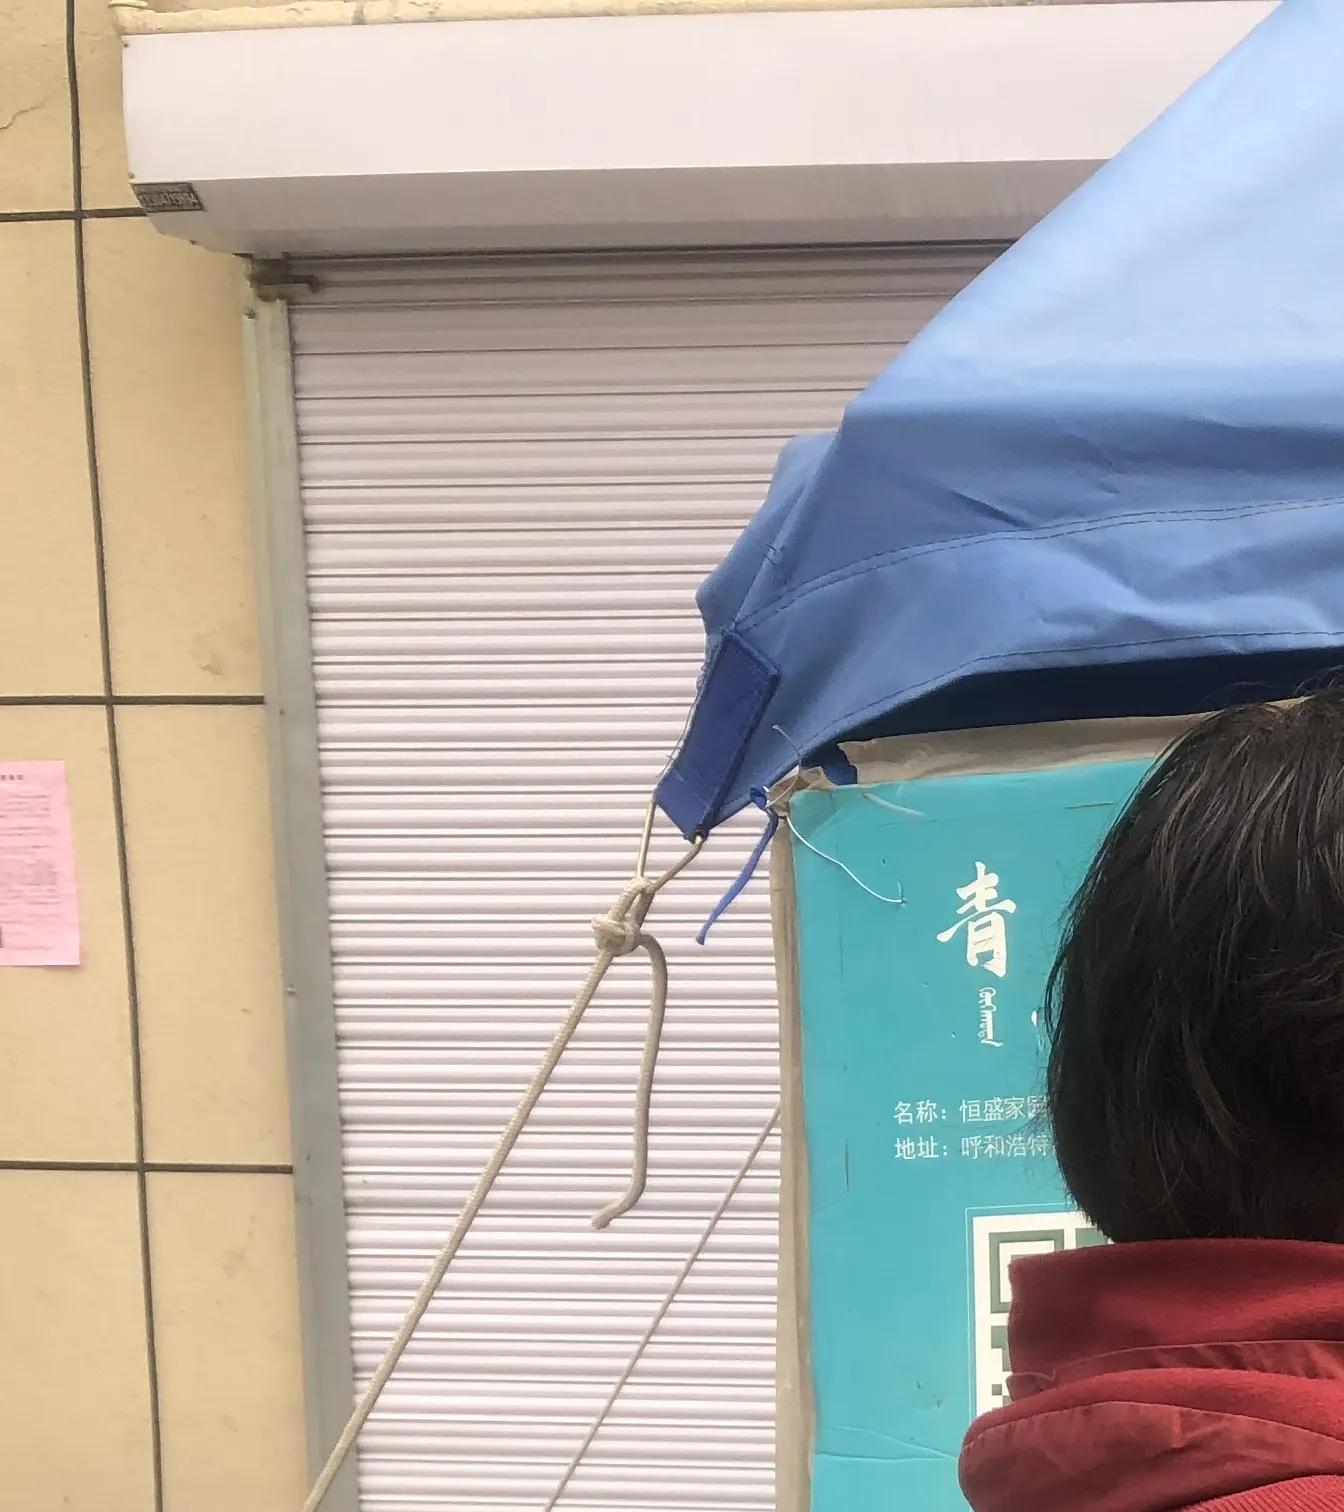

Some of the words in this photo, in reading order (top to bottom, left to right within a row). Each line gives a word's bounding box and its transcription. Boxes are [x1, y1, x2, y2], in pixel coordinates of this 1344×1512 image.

[936, 861, 1017, 978] 青
[894, 1134, 1056, 1160] 地址：呼和浩特
